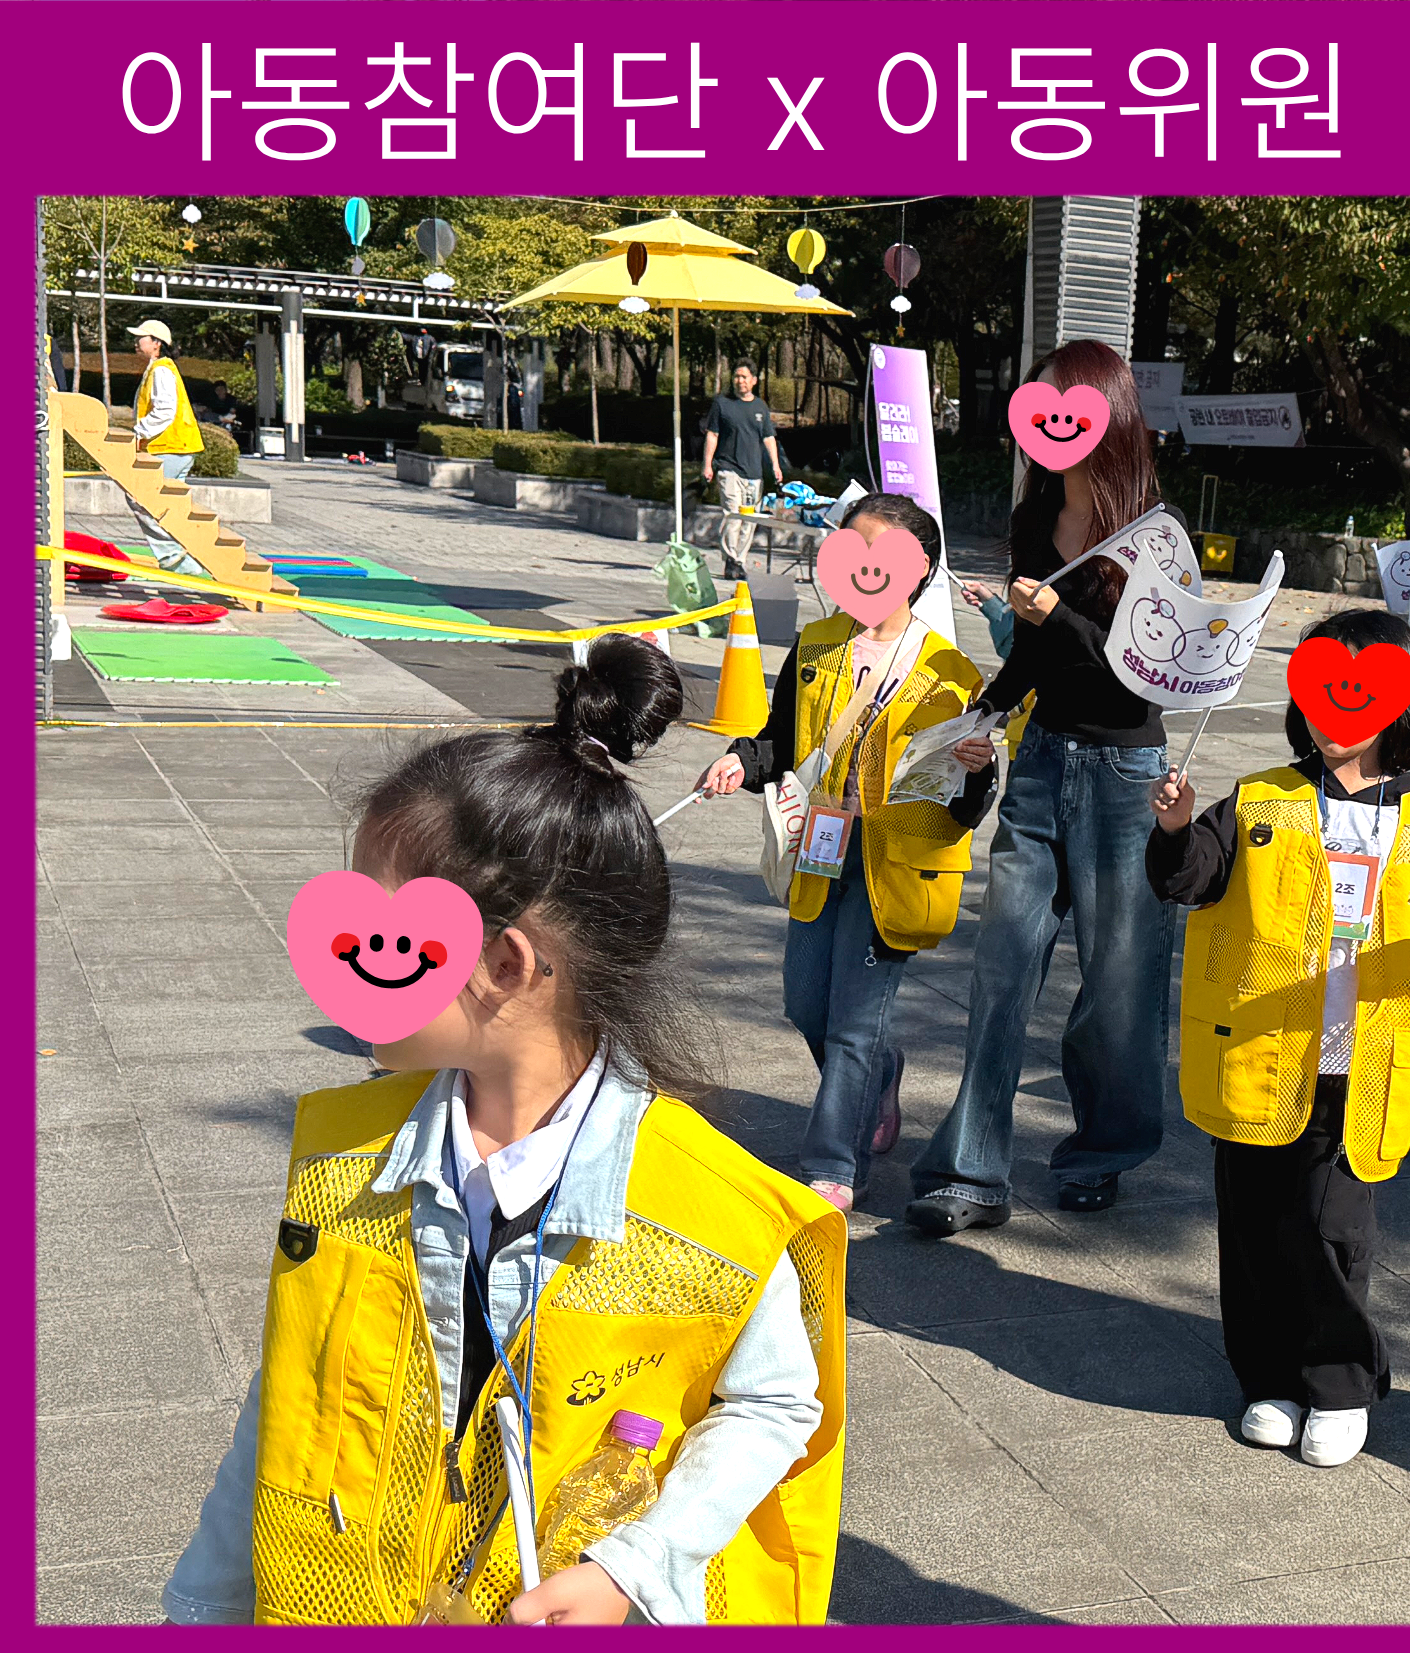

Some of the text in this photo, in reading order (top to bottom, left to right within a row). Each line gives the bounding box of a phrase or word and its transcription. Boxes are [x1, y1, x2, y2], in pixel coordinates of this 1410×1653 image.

[1122, 647, 1180, 693] 성남시
[1334, 882, 1356, 895] 2조
[611, 1351, 666, 1388] 성남시
